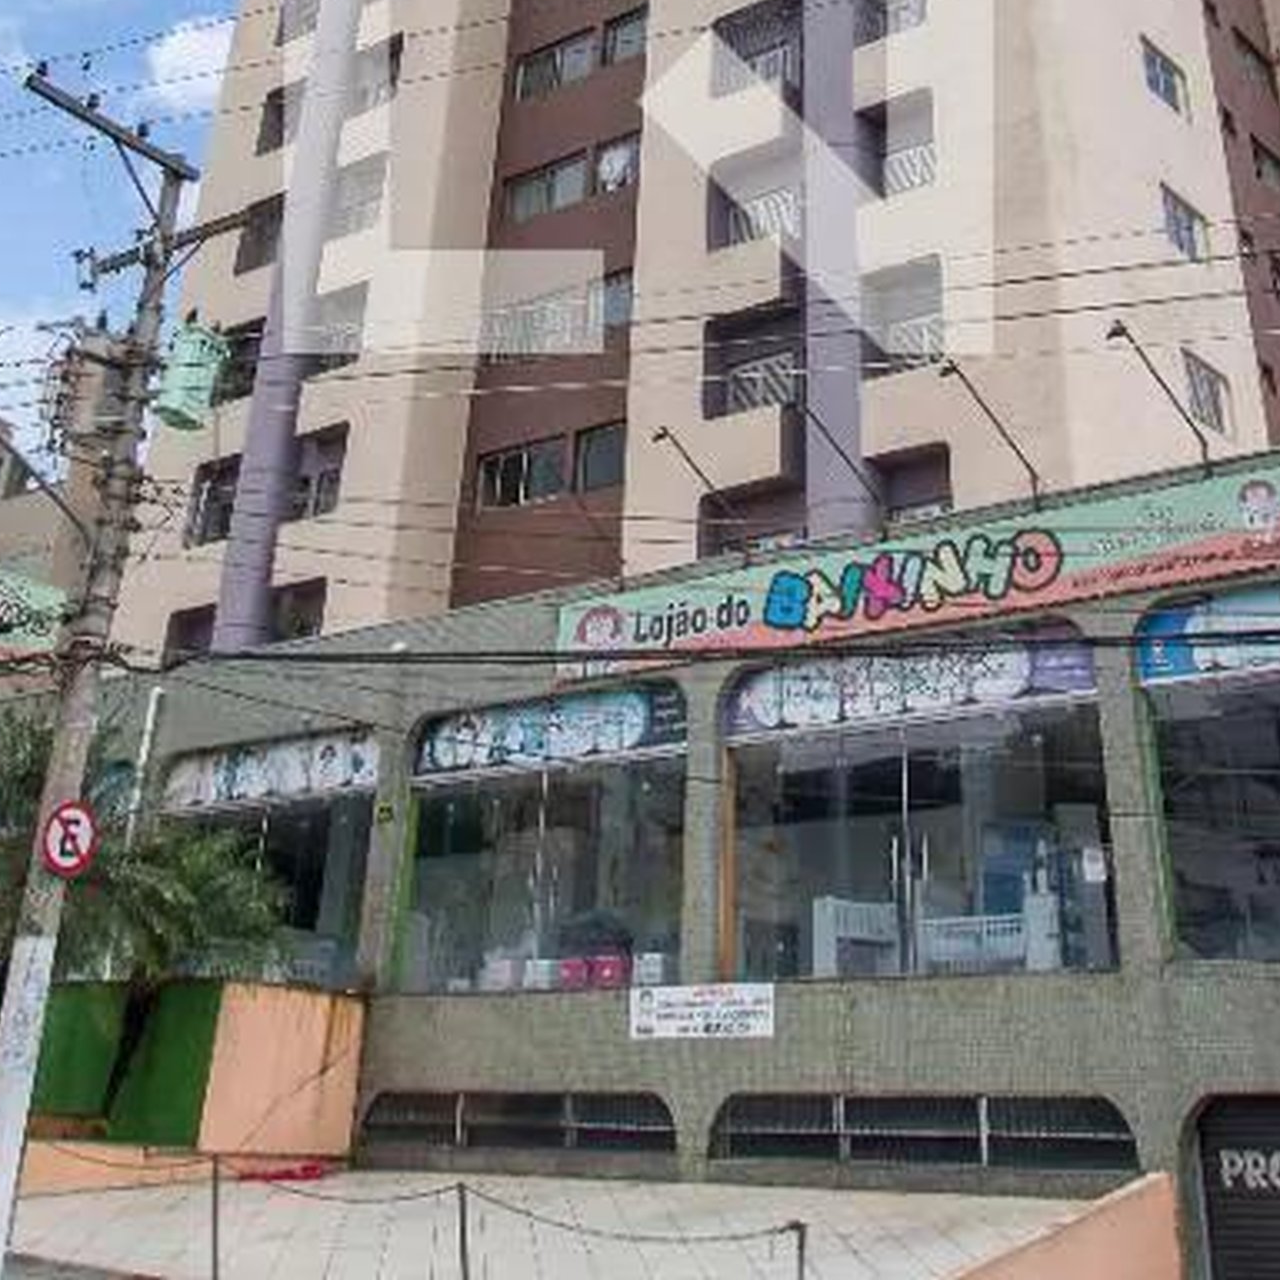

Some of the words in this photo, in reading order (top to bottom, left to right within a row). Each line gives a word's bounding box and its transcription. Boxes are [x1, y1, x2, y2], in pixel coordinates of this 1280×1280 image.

[632, 600, 706, 648] Lojão
[716, 594, 751, 631] do
[763, 527, 1064, 633] BAIXINHO
